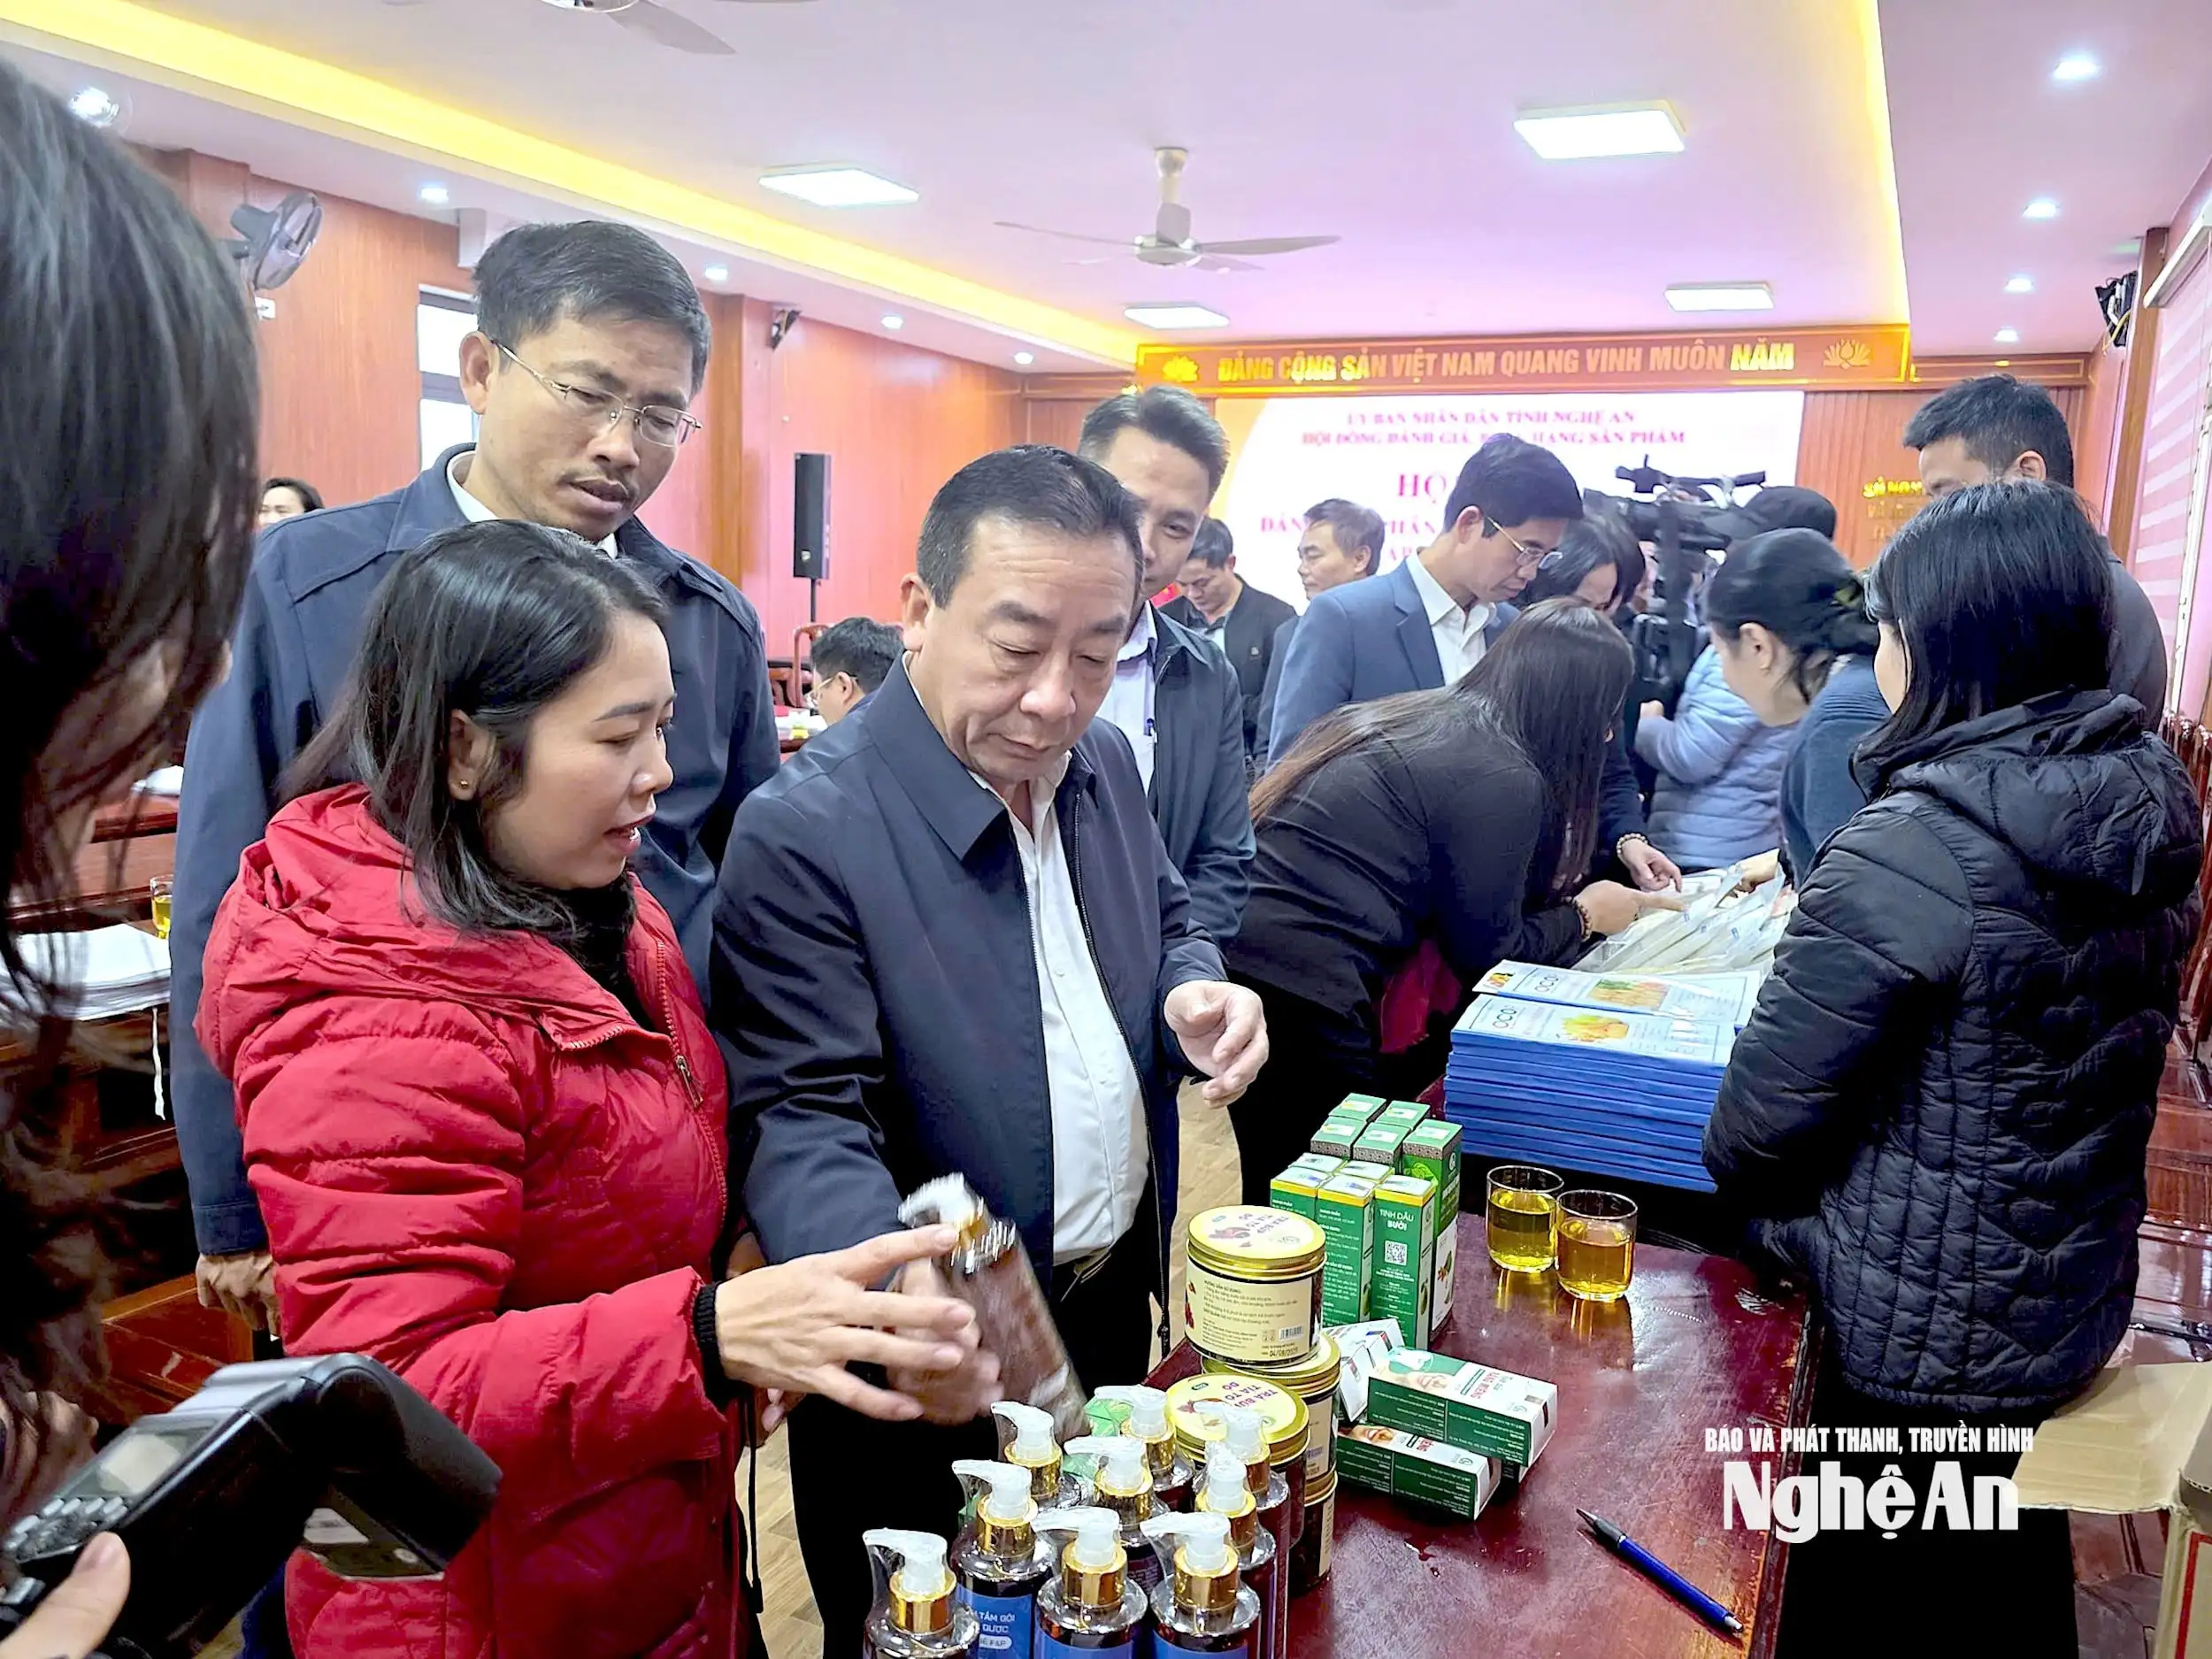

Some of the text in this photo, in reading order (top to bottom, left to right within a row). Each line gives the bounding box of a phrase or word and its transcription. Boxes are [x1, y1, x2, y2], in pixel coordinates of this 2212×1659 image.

[1217, 337, 1794, 384] ĐẢNG CỘNG SẢN VIỆT NAM QUANG VINH MUÔN NĂM
[1609, 411, 1634, 424] AN
[1379, 1209, 1396, 1219] TINH
